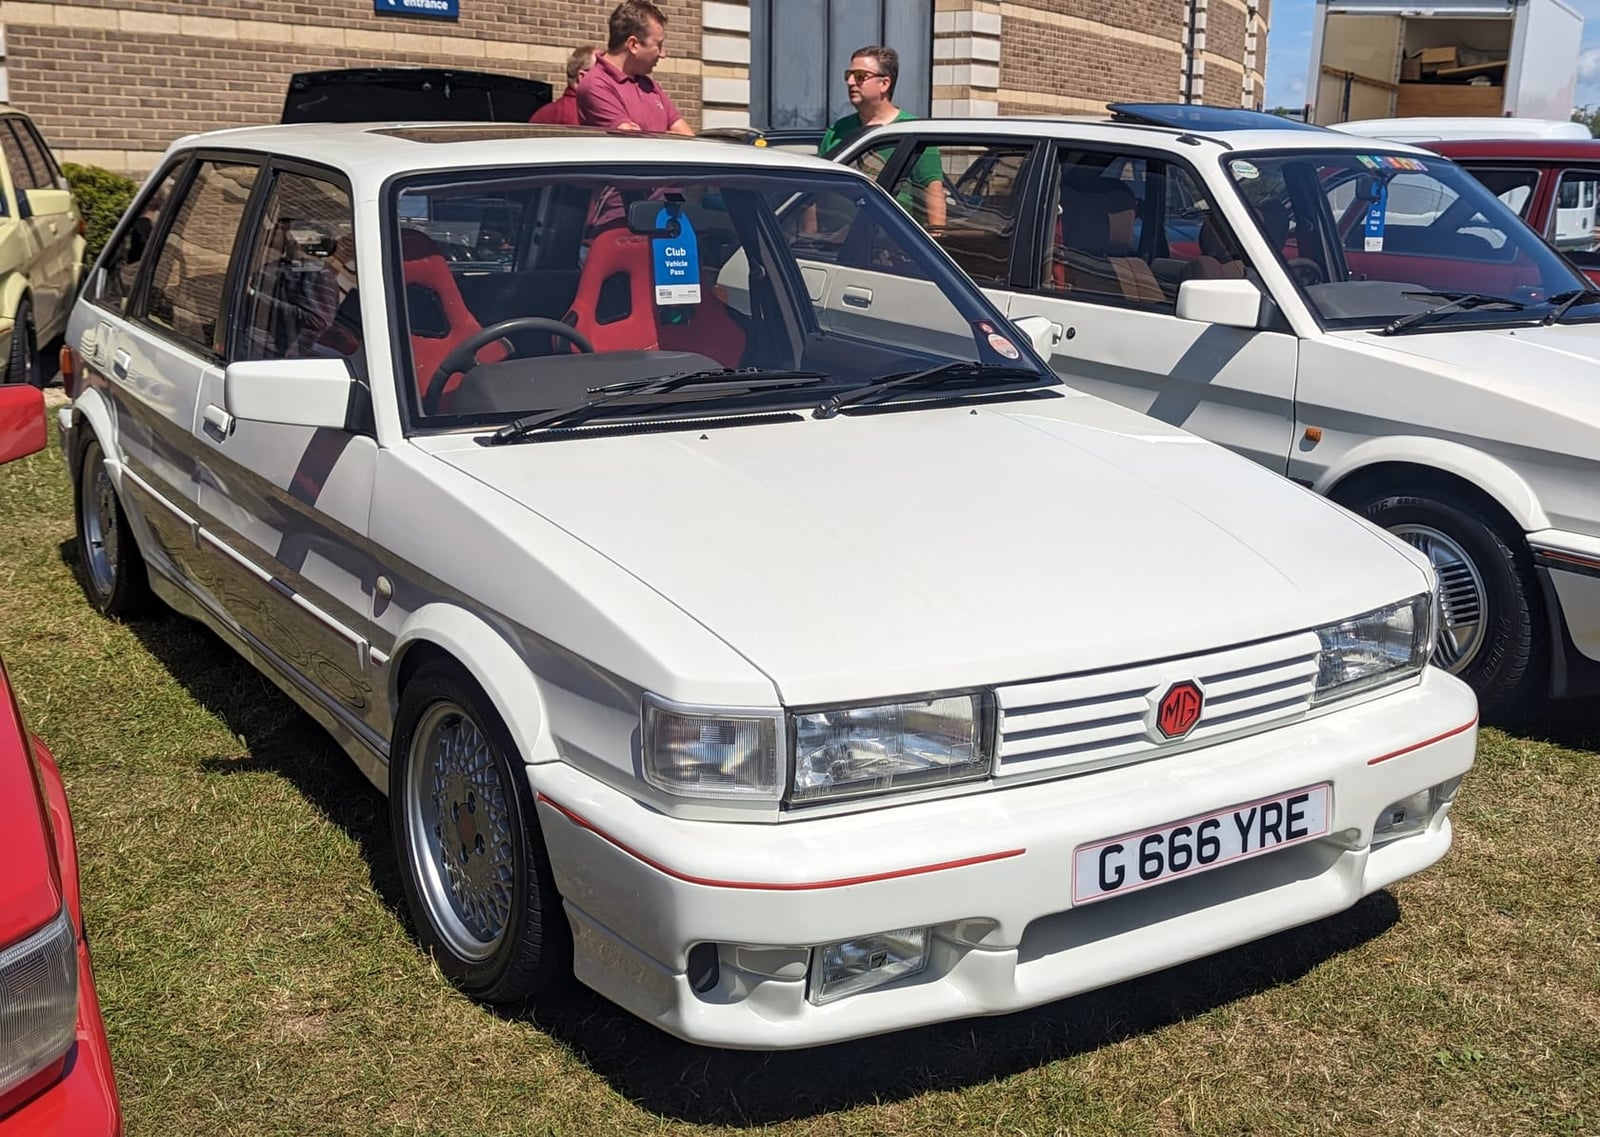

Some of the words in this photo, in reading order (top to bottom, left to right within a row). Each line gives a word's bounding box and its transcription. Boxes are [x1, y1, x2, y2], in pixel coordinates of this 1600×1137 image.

[403, 0, 449, 10] entrance
[665, 246, 687, 257] Club
[664, 259, 688, 268] Vehicle
[669, 268, 685, 276] Pass
[1164, 690, 1197, 729] MG
[1098, 843, 1126, 892] G
[1138, 818, 1221, 881] 666
[1233, 793, 1310, 854] YRE
